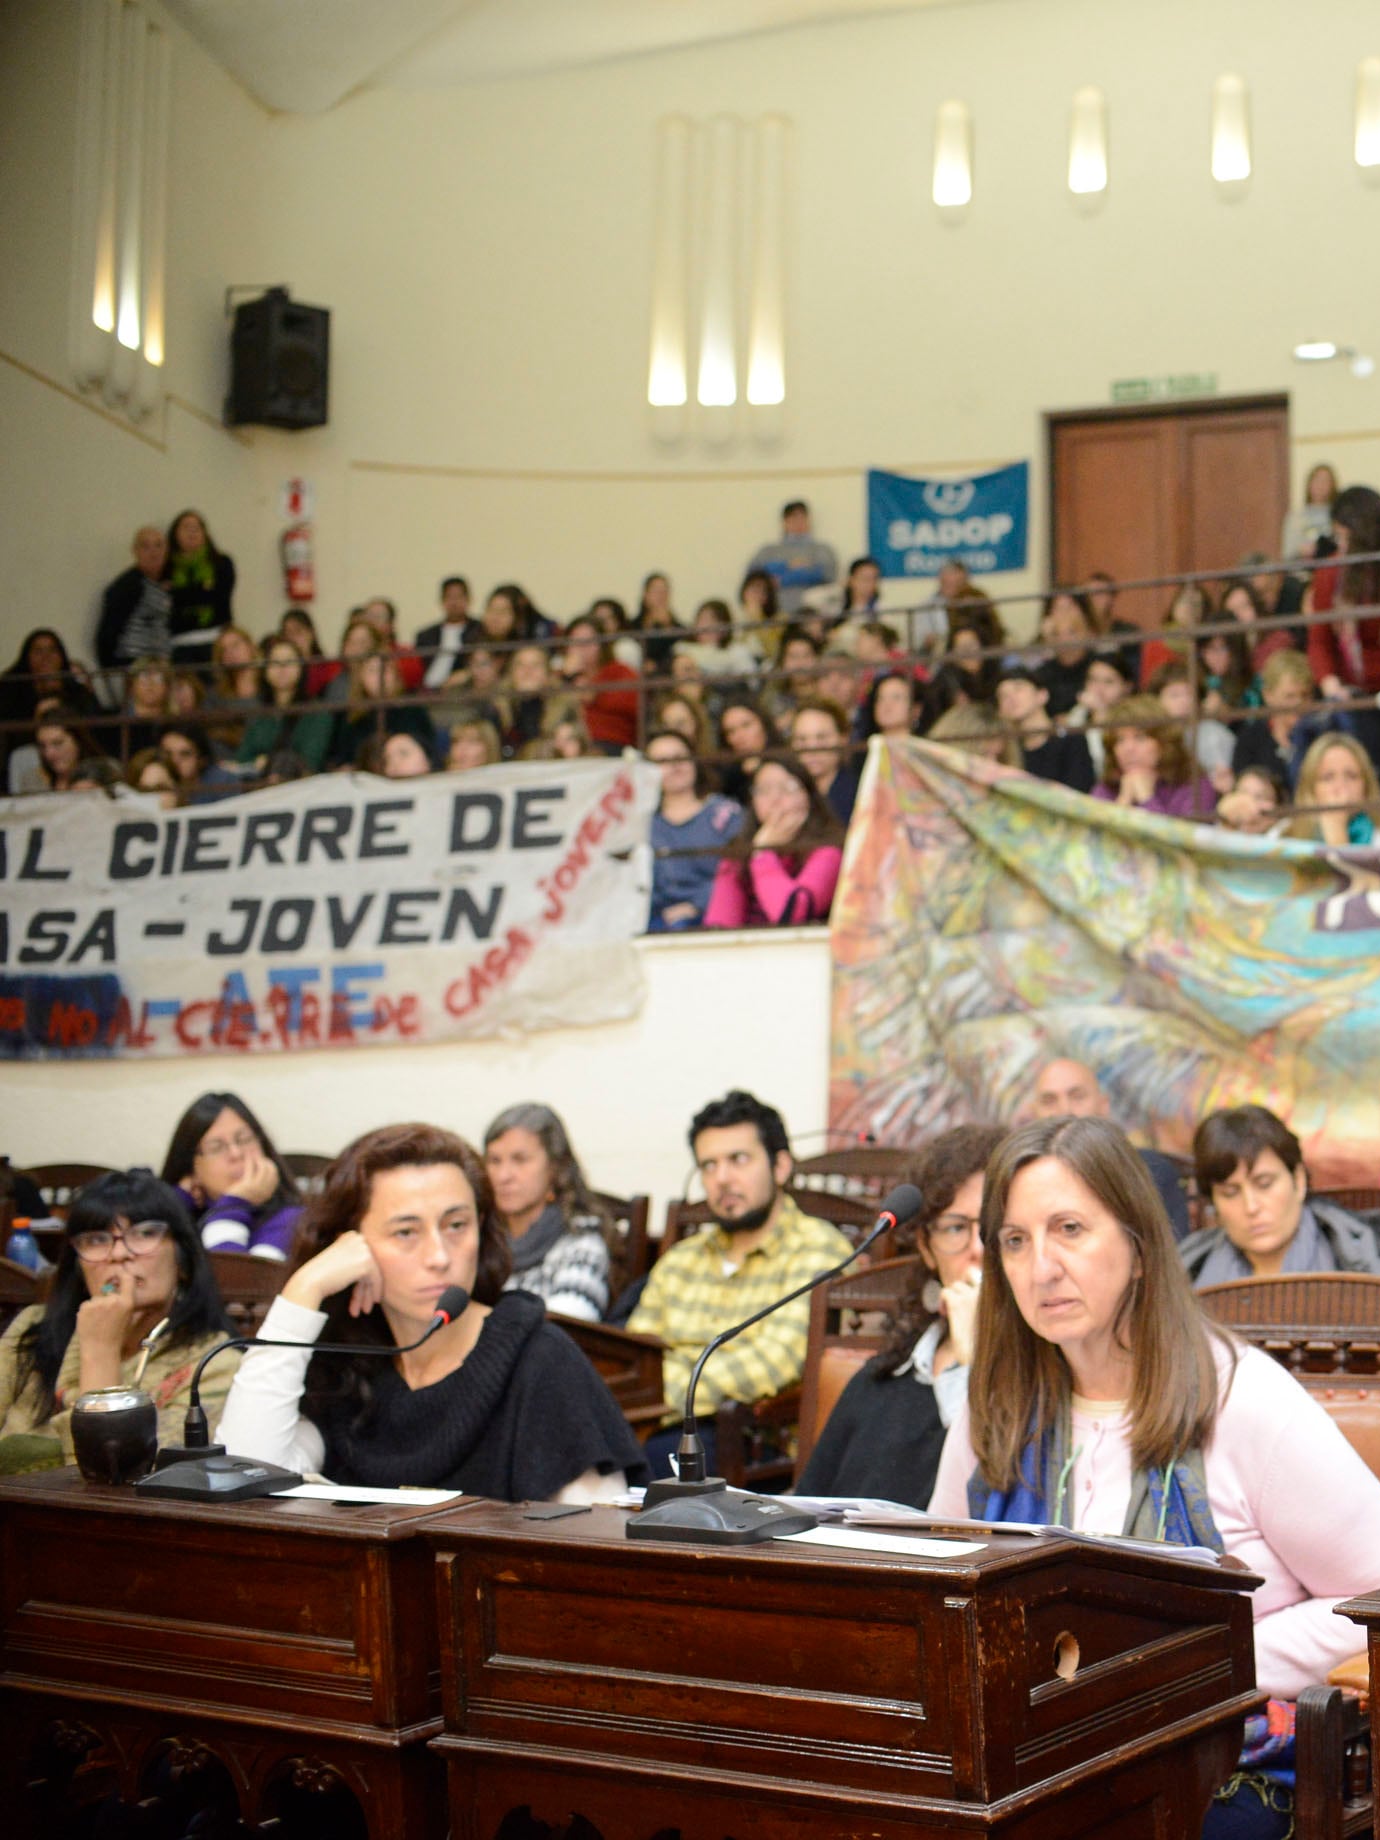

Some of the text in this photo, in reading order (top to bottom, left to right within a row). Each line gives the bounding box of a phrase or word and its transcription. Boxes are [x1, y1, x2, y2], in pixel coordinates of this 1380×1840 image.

[888, 513, 1013, 550] SADOP
[108, 799, 414, 881] CIERRE
[448, 786, 567, 853] DE
[205, 885, 505, 957] JOVEN
